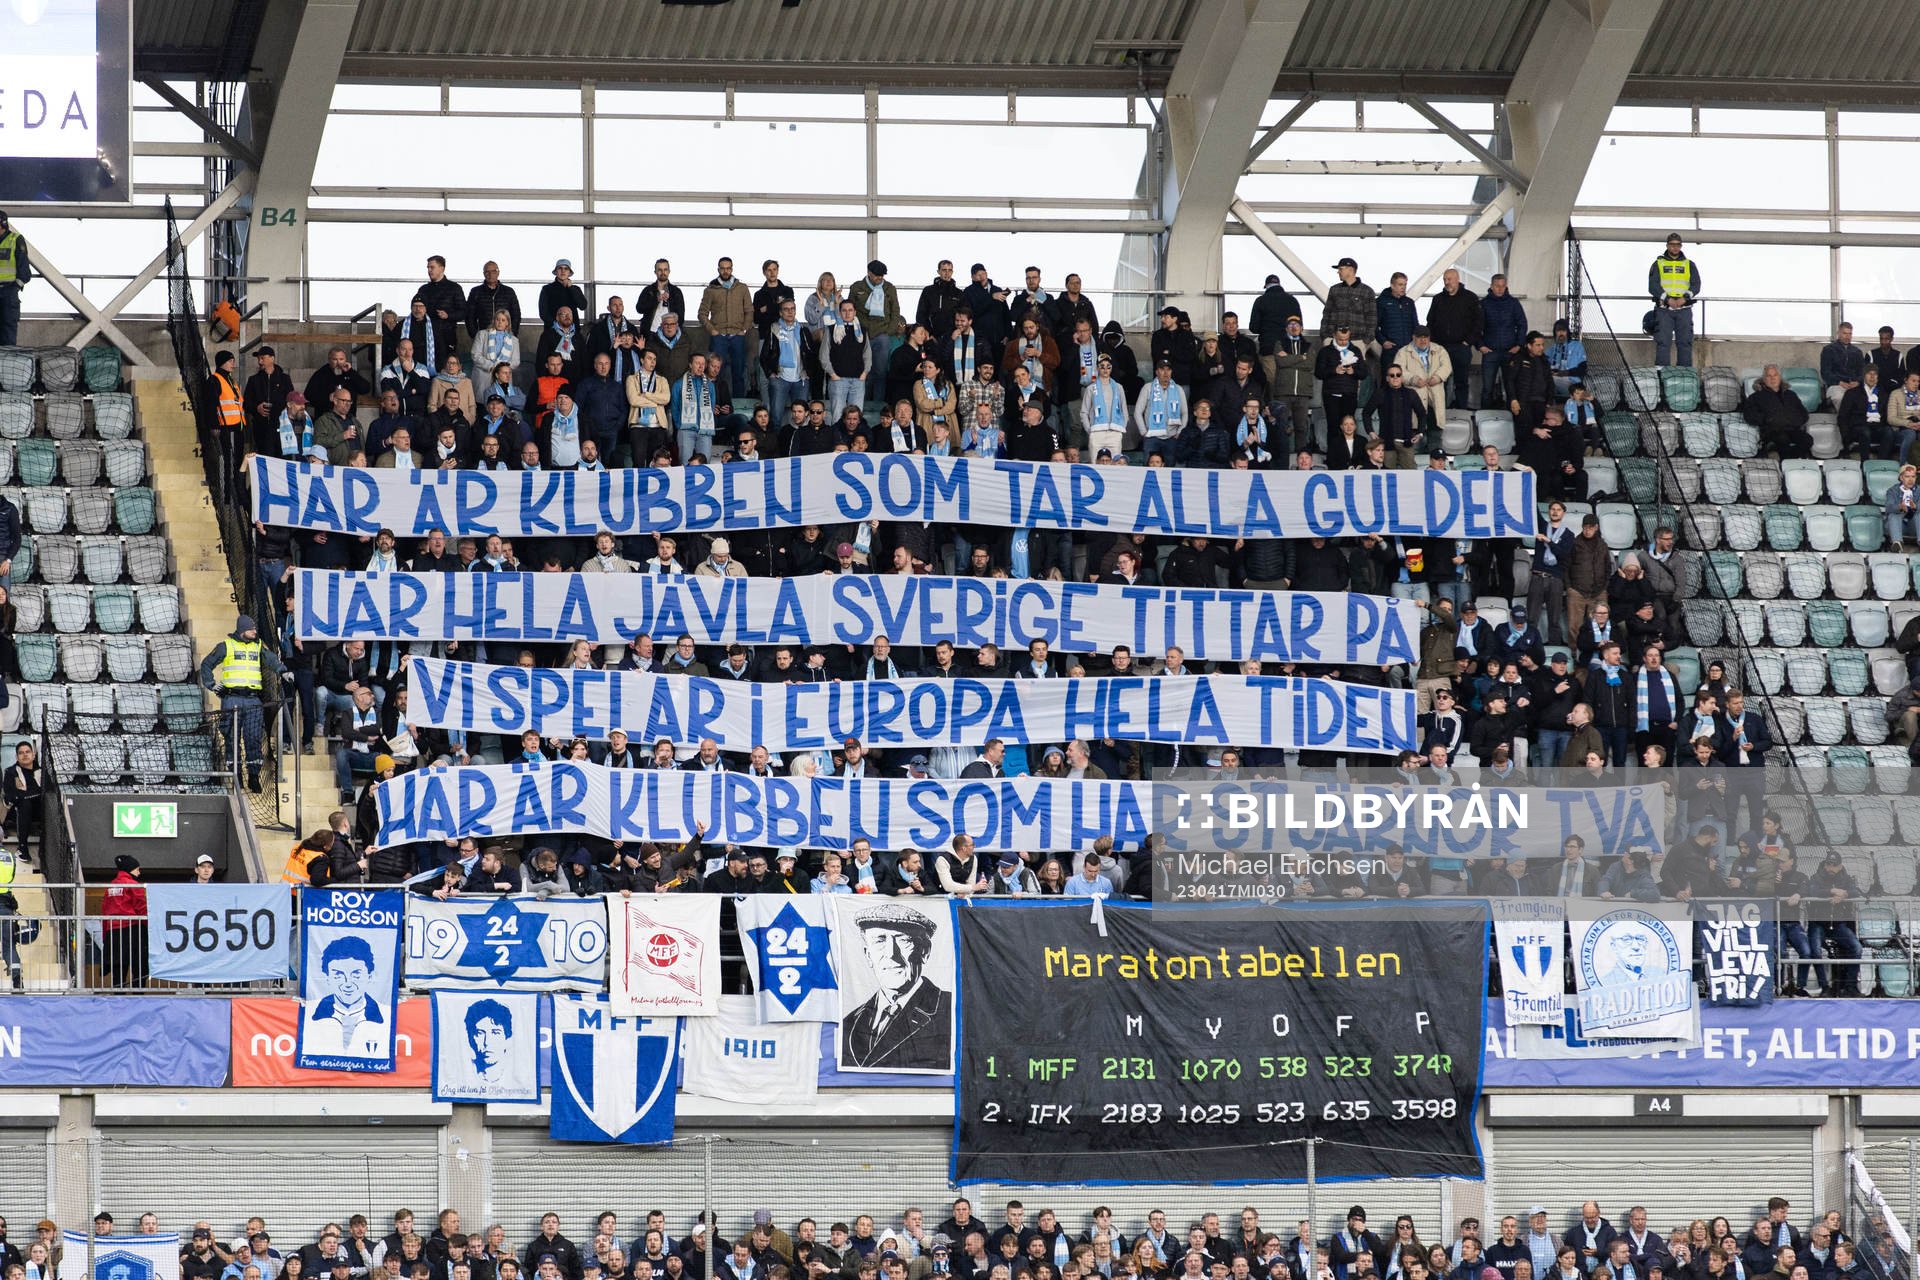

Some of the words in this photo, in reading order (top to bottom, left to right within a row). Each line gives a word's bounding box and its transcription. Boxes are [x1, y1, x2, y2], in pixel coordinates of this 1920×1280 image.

[0, 89, 88, 129] DA
[261, 208, 297, 227] B4
[256, 456, 381, 532] HÄR
[410, 469, 500, 535] ÄR
[520, 456, 802, 536] KLUBBEN
[833, 452, 970, 520] SOM
[994, 461, 1109, 528] TAR
[1133, 469, 1282, 537] ALLA
[1303, 470, 1534, 538] GULDEN
[302, 570, 428, 638] NÄR
[443, 571, 599, 641] HELA
[613, 573, 811, 644] JÄVLA
[1346, 592, 1416, 664] PÅ
[487, 667, 726, 744] SPELAR
[786, 679, 1029, 747] EUROPA
[1065, 676, 1229, 744] HELA
[282, 793, 290, 803] 5
[378, 766, 497, 846] HÄR
[511, 761, 587, 834] ÄR
[610, 770, 890, 850] KLUBBEN
[907, 780, 1052, 850] SOM
[1071, 780, 1192, 851] HAR
[1546, 786, 1663, 856] TVÅ
[331, 891, 374, 908] ROY
[307, 907, 398, 926] HODGSON
[487, 915, 518, 937] 24
[1705, 902, 1761, 930] JAG
[165, 908, 275, 953] 5650
[408, 915, 459, 959] 19
[550, 919, 606, 964] 10
[766, 927, 809, 955] 24
[1517, 936, 1546, 945] MFF
[494, 946, 509, 967] 2
[1043, 945, 1401, 980] Maratontabellen
[1706, 950, 1771, 977] LEVA
[778, 966, 802, 995] 2
[1507, 989, 1562, 1012] Framtid
[1579, 976, 1689, 1024] TRADITION
[1126, 1013, 1142, 1037] M
[1273, 1013, 1290, 1037] O
[1336, 1014, 1353, 1037] F
[1415, 1011, 1431, 1035] P
[724, 1037, 776, 1059] 1910
[1767, 1028, 1895, 1059] ALLTID
[367, 1061, 372, 1069] i
[986, 1056, 1012, 1079] 1.
[1029, 1058, 1077, 1080] MFF
[1103, 1057, 1156, 1080] 2131
[1181, 1059, 1242, 1082] 1070
[1260, 1057, 1308, 1078] 538
[1324, 1056, 1372, 1077] 523
[983, 1102, 1012, 1123] 2.
[1029, 1104, 1073, 1125] IFK
[1102, 1103, 1162, 1124] 2183
[1177, 1103, 1240, 1125] 1025
[1257, 1101, 1305, 1123] 523
[1323, 1100, 1371, 1121] 635
[1392, 1098, 1457, 1120] 3598
[1648, 1098, 1671, 1112] A4
